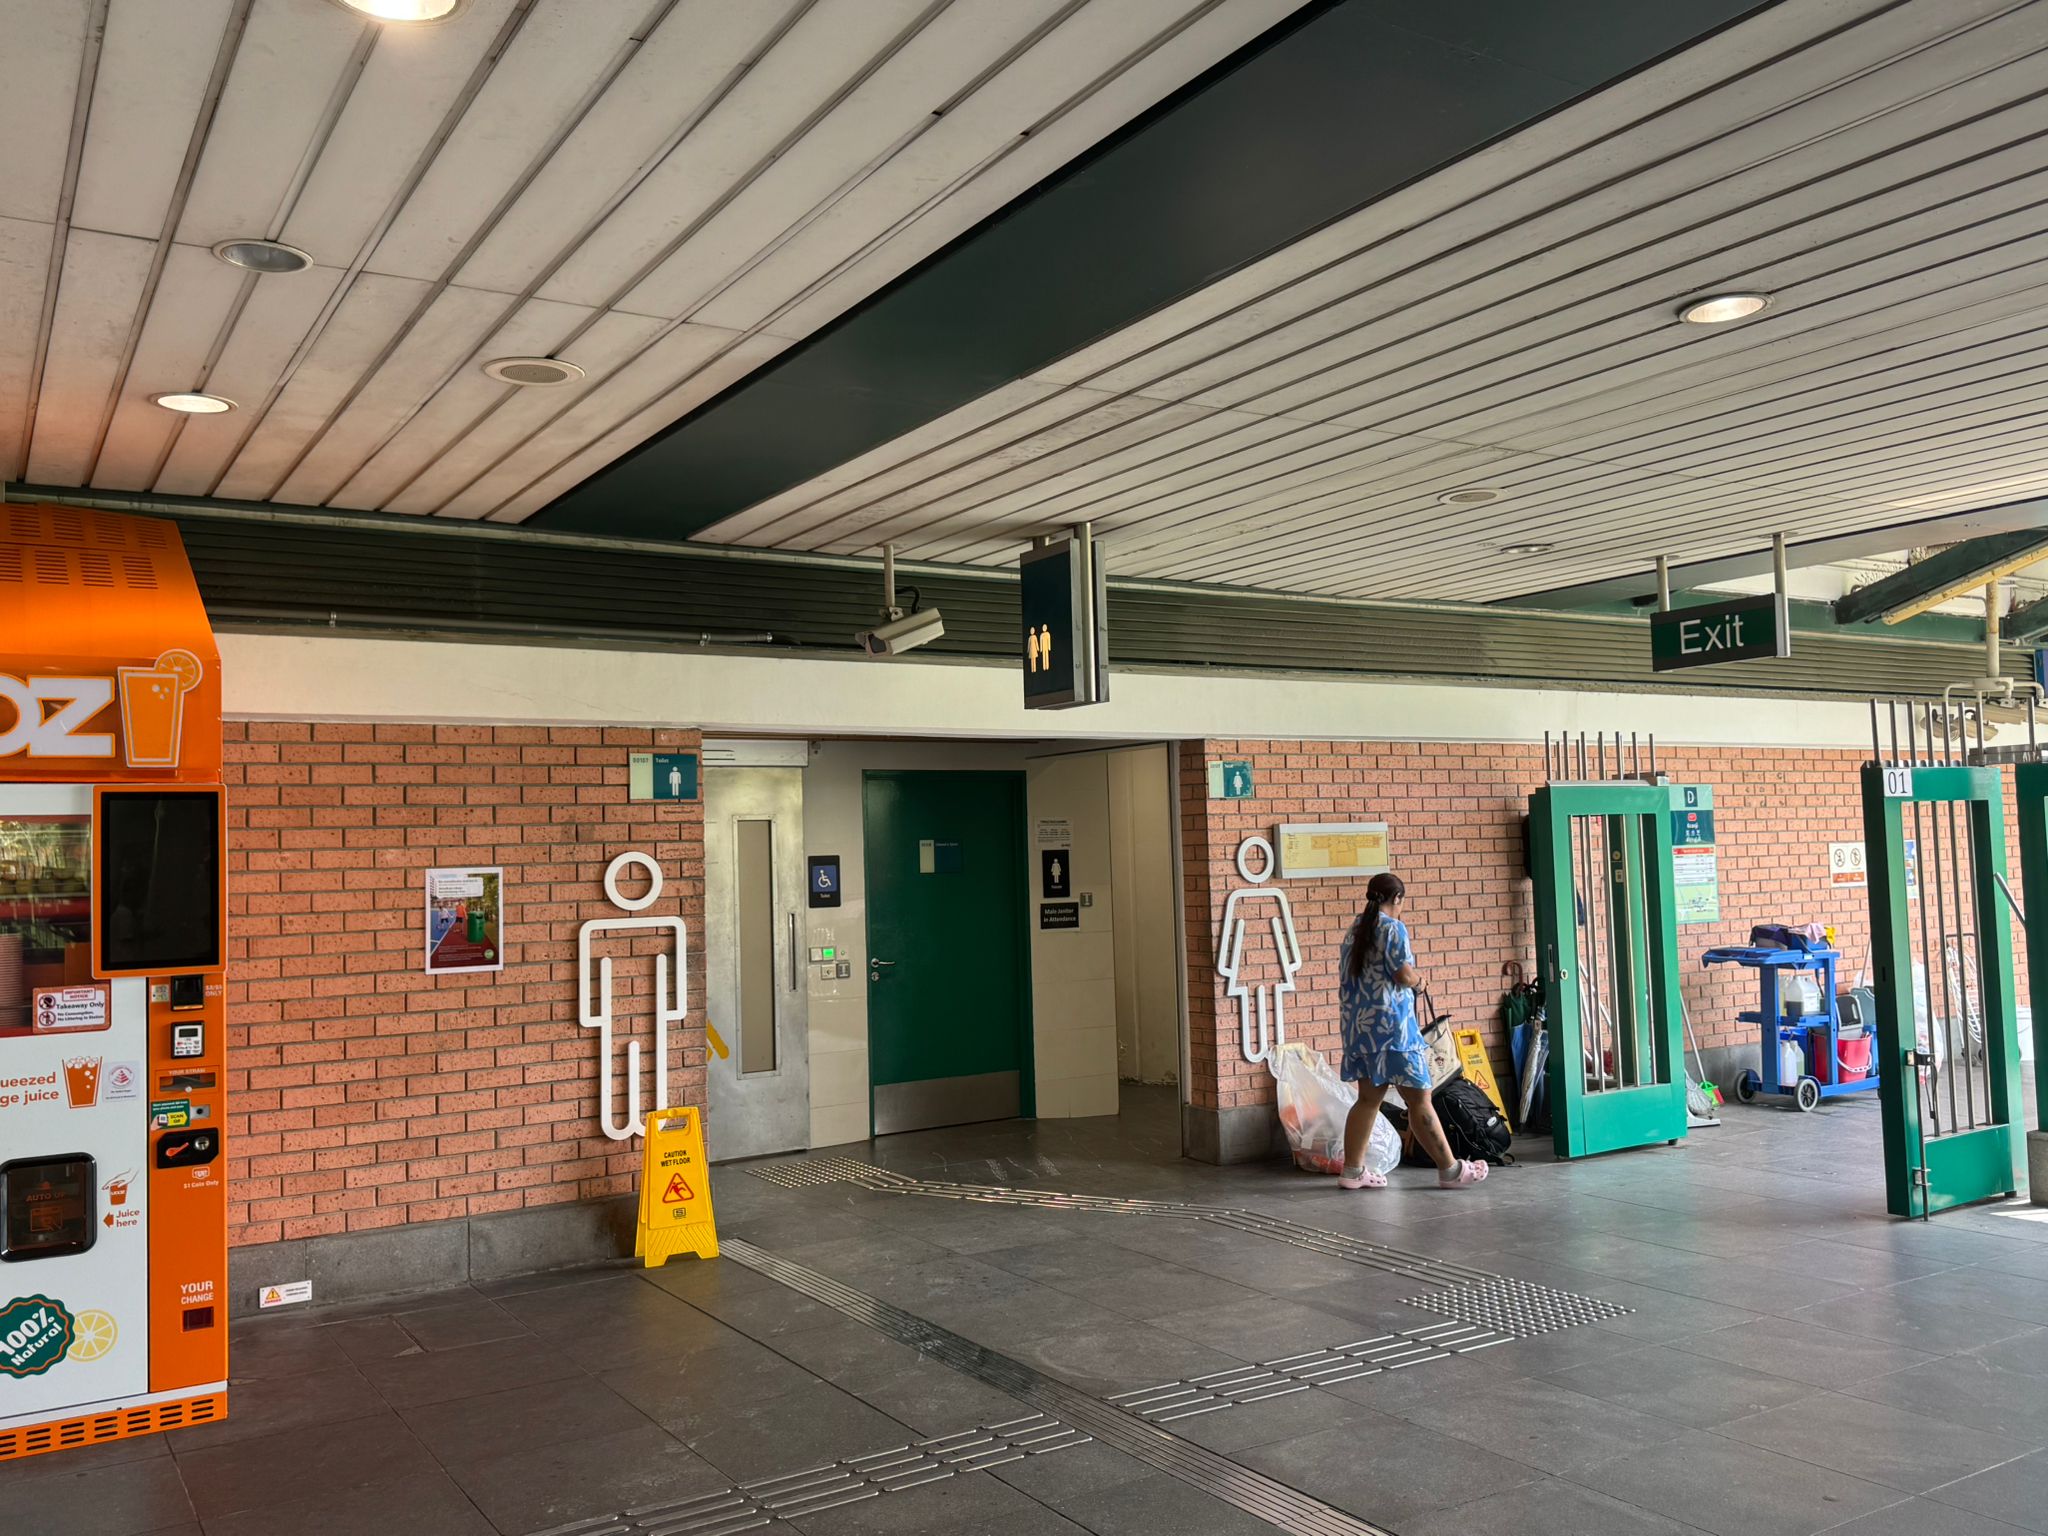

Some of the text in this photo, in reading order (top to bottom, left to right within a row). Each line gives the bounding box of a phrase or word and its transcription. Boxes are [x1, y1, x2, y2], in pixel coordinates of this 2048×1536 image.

[1680, 614, 1744, 655] Exit
[1887, 771, 1908, 795] 01
[1687, 790, 1695, 804] D
[0, 1071, 56, 1088] ueezed
[23, 1089, 59, 1105] juice
[664, 1150, 687, 1158] CAUTION
[673, 1157, 690, 1165] FLOOR
[116, 1209, 140, 1218] Juice
[116, 1219, 138, 1228] here
[180, 1280, 214, 1294] YOUR
[180, 1292, 214, 1305] CHANGE
[0, 1307, 55, 1356] 100%
[11, 1322, 63, 1366] Natural
